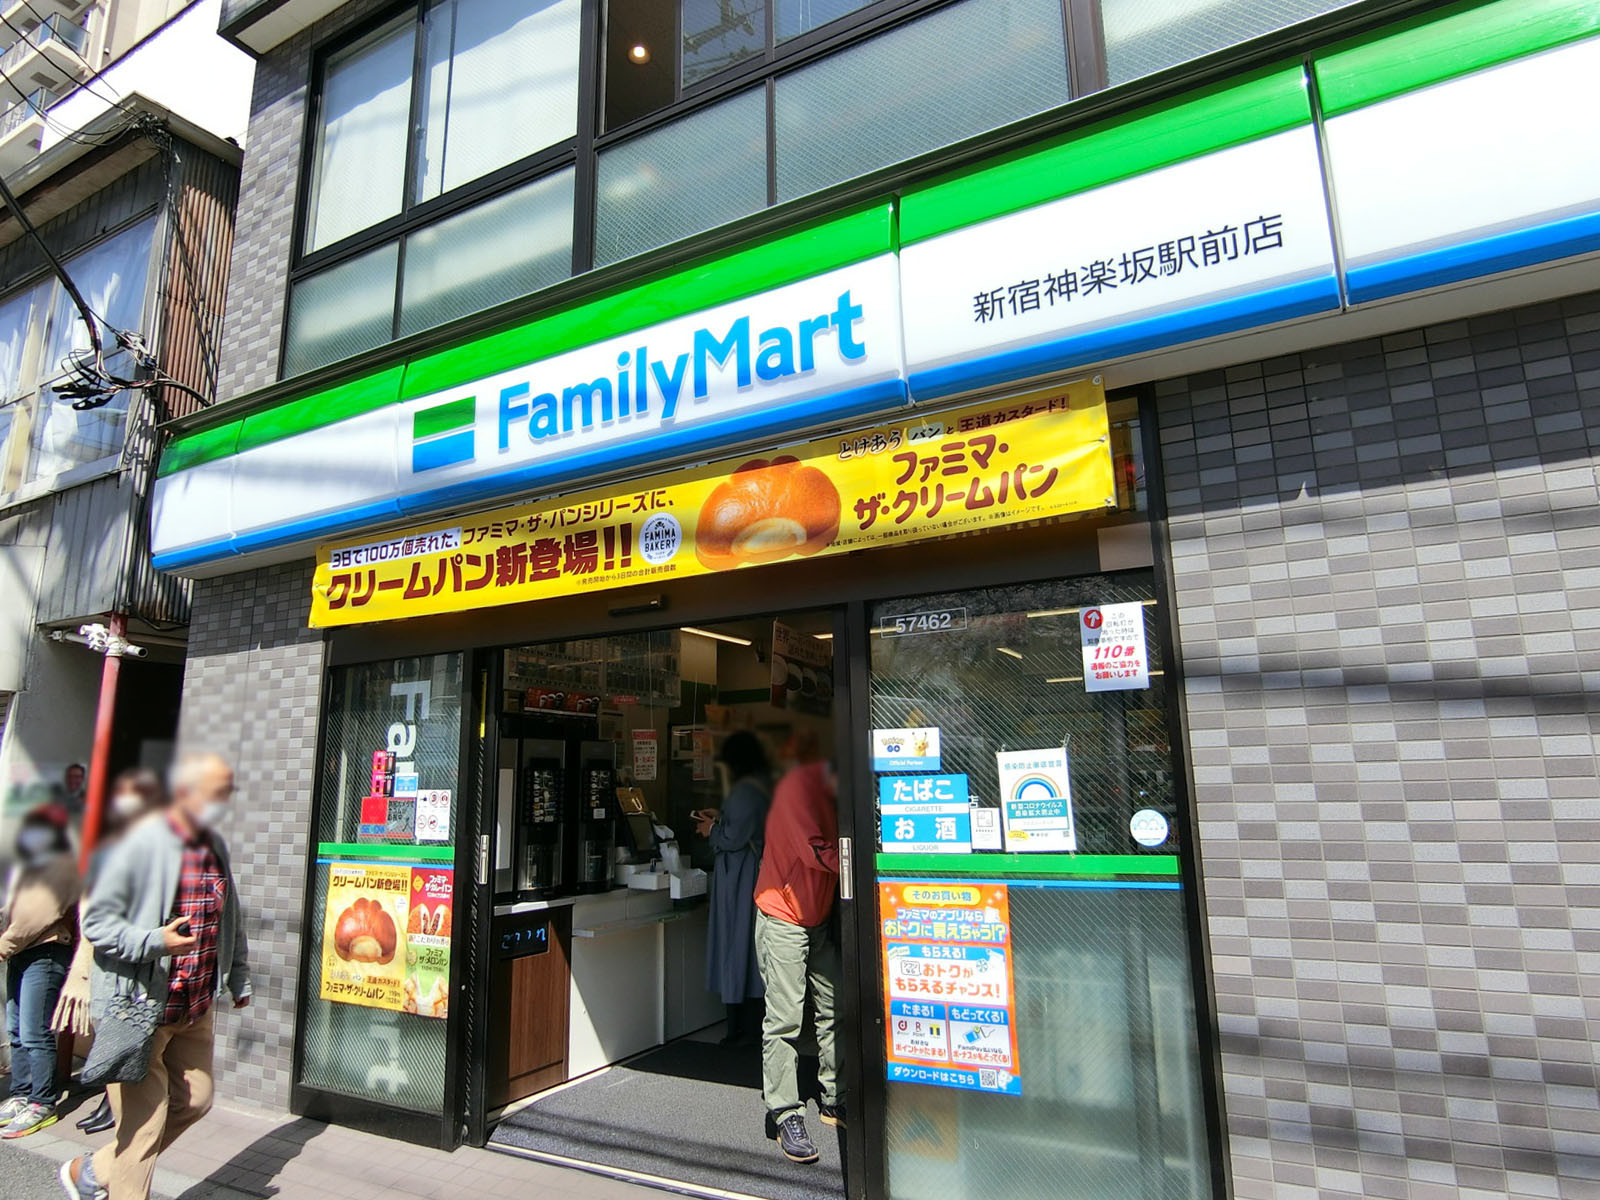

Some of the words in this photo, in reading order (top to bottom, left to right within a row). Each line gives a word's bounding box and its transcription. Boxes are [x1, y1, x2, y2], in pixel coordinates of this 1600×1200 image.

[973, 214, 1283, 323] 新宿神楽坂駅前店
[499, 290, 865, 452] FamilyMart
[839, 431, 902, 459] とけあう
[853, 464, 1058, 530] ザ・クリームパン
[644, 528, 676, 542] FAMIMA
[332, 532, 458, 568] 3日で100万個売れた、
[644, 538, 676, 553] BAKERY
[326, 522, 633, 610] クリームパン新登場!!
[895, 613, 951, 633] 57462
[1111, 612, 1126, 620] この
[1094, 645, 1136, 660] 110番
[1090, 660, 1141, 670] 通報のご協力を
[1095, 669, 1137, 678] お願いします
[893, 778, 954, 801] たばこ
[904, 805, 944, 813] CIGARETTE
[912, 844, 939, 852] LIQUOR
[912, 890, 972, 902] そのお買い物
[897, 908, 984, 922] ファミマのアプリなら
[884, 921, 1007, 941] おトクに買えちゃう!?
[921, 945, 967, 959] もらえる!
[923, 963, 974, 978] おトクが
[895, 977, 1000, 998] もらえるチャンス!
[901, 1003, 935, 1017] たまる!
[951, 1007, 1004, 1024] もどってくる!
[893, 1066, 975, 1084] ダウンロードはこちら
